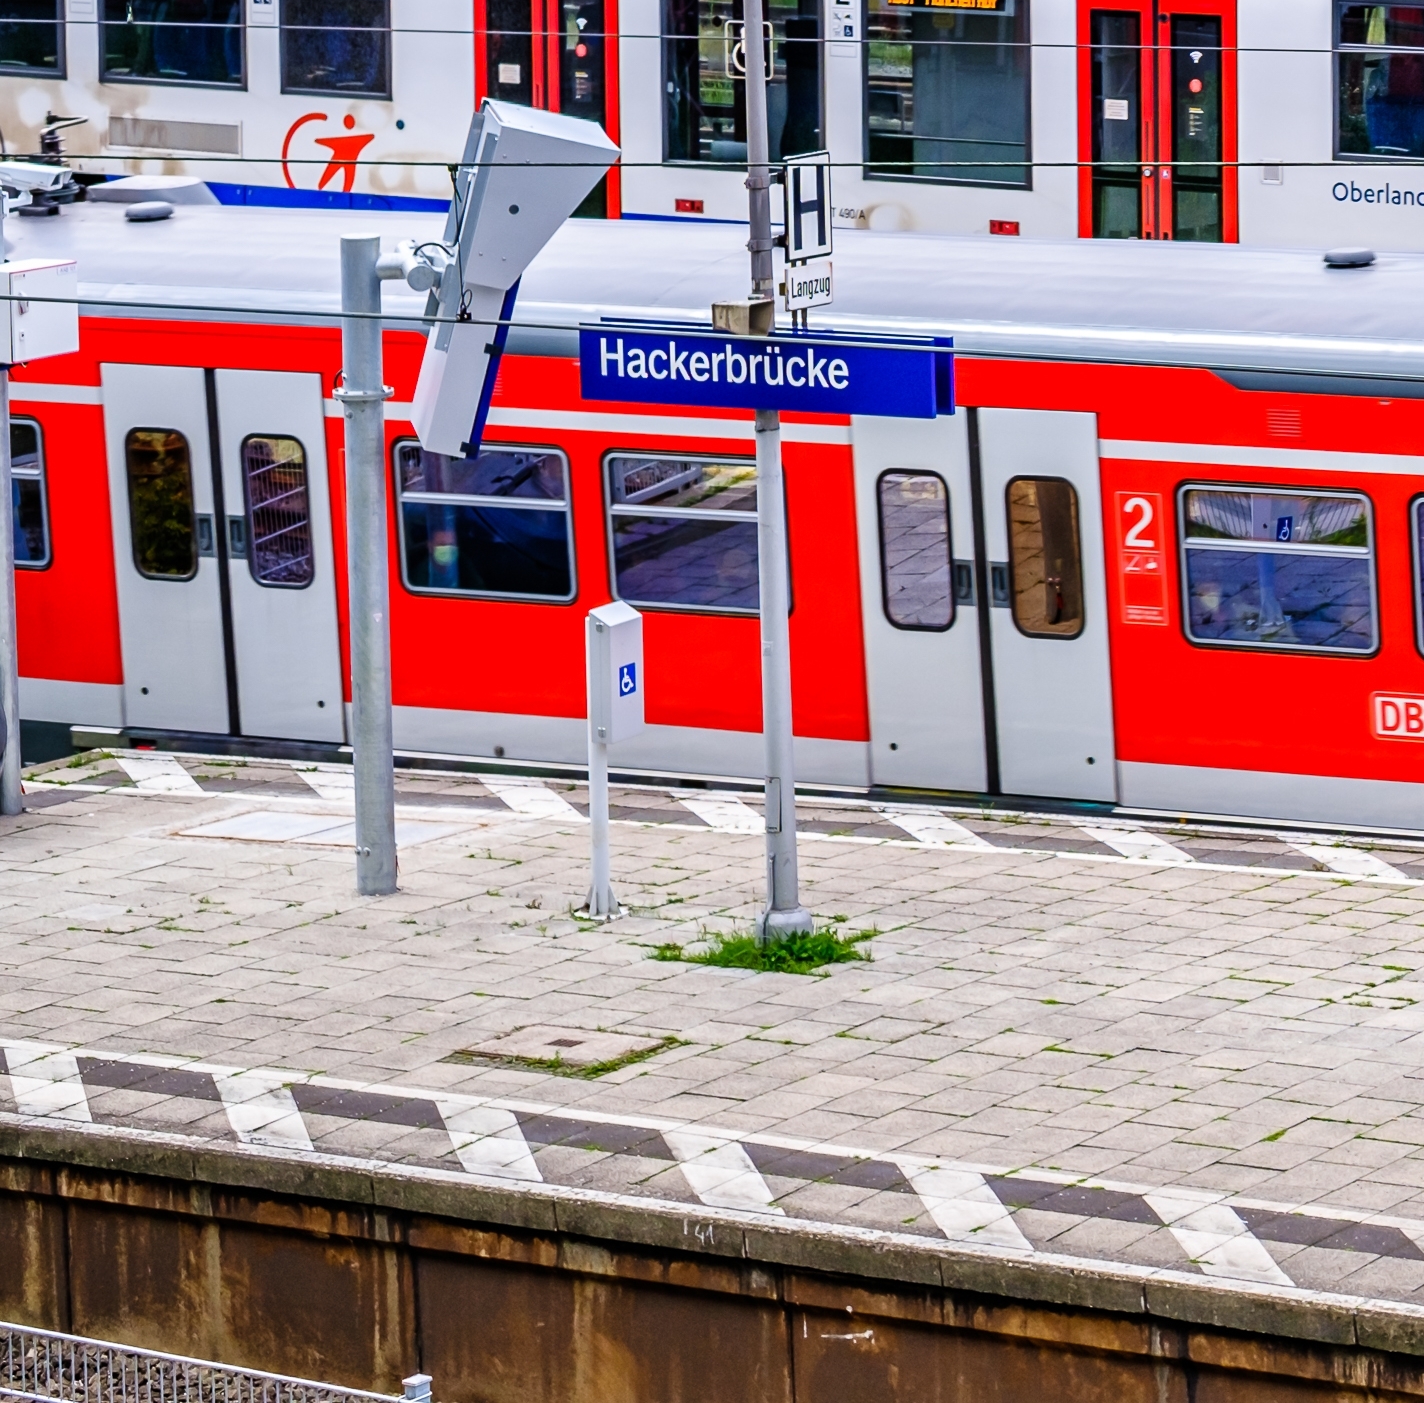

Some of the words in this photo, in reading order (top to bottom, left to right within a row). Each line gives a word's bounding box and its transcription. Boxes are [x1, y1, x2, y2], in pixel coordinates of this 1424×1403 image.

[793, 165, 825, 252] H
[791, 276, 831, 300] Langzug
[599, 338, 850, 390] Hackerbrücke
[1123, 497, 1155, 548] 2
[1381, 700, 1424, 736] DB
